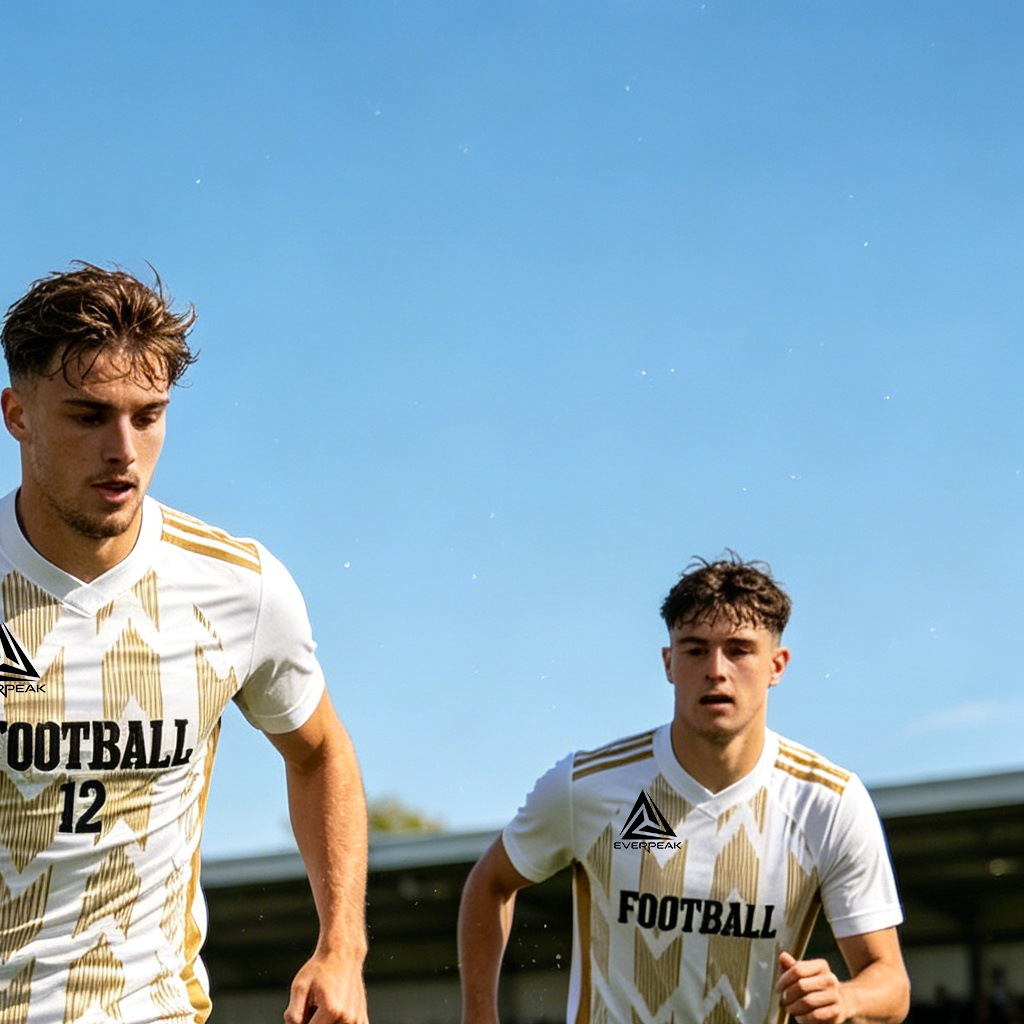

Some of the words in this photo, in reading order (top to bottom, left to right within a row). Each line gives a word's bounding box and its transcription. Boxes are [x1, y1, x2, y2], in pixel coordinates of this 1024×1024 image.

[58, 779, 107, 834] 12
[613, 842, 681, 853] EVERPEAK
[617, 890, 777, 939] FOOTBALL
